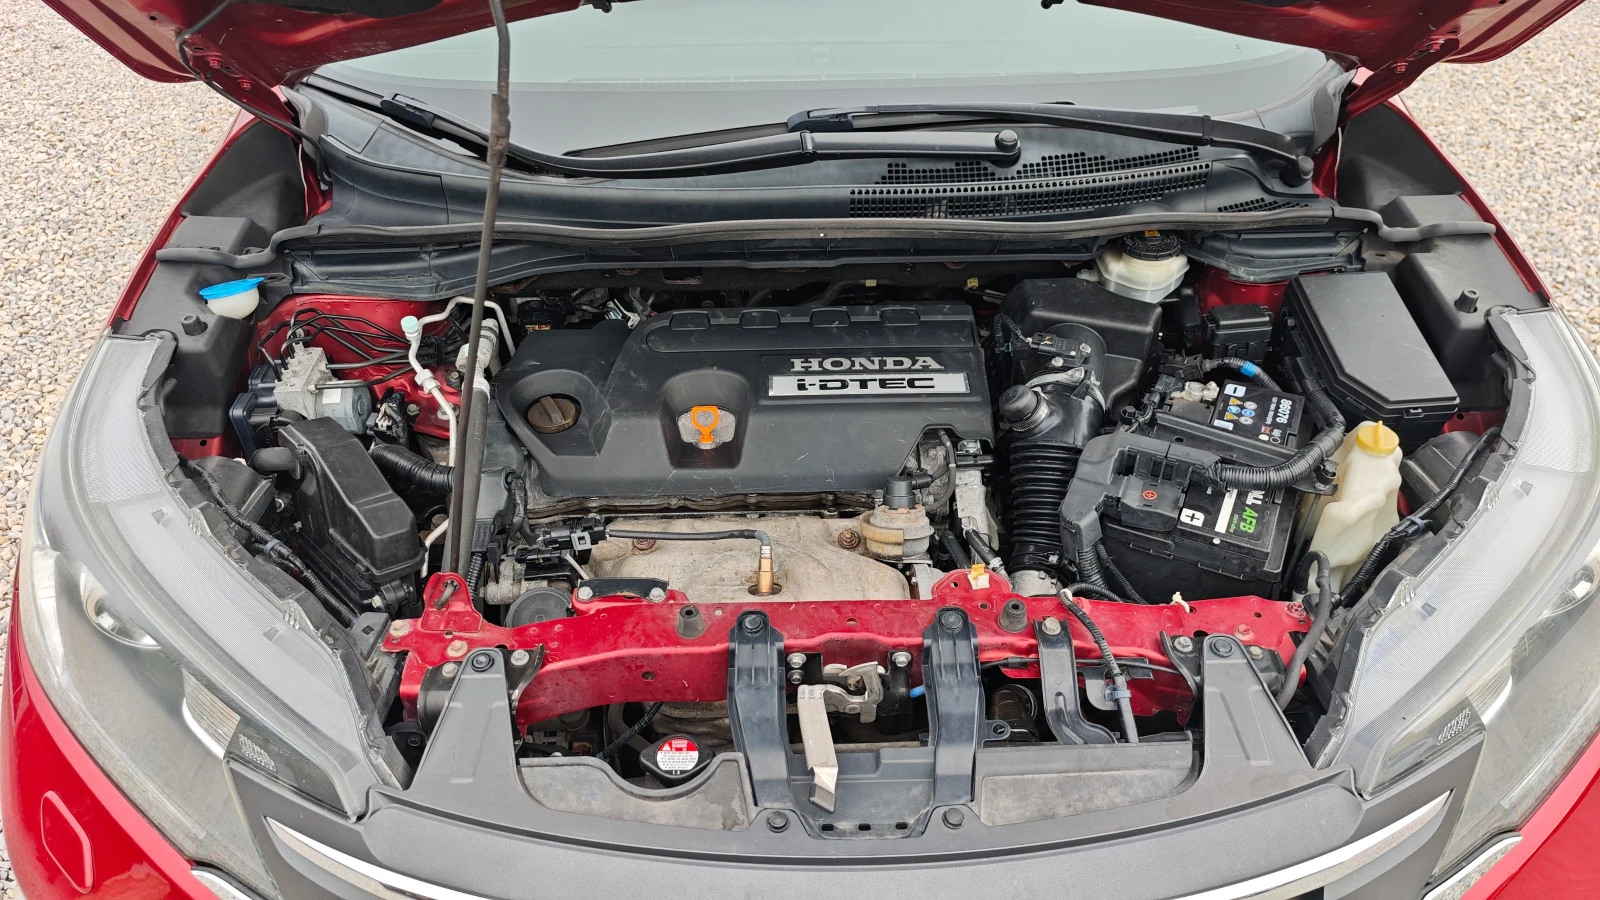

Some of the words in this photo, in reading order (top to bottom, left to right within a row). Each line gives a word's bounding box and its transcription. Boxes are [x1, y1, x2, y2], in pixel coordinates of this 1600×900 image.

[790, 356, 945, 372] HONDA
[796, 377, 936, 392] i-DTEC
[1275, 398, 1293, 424] 86076
[1240, 506, 1258, 534] AFB
